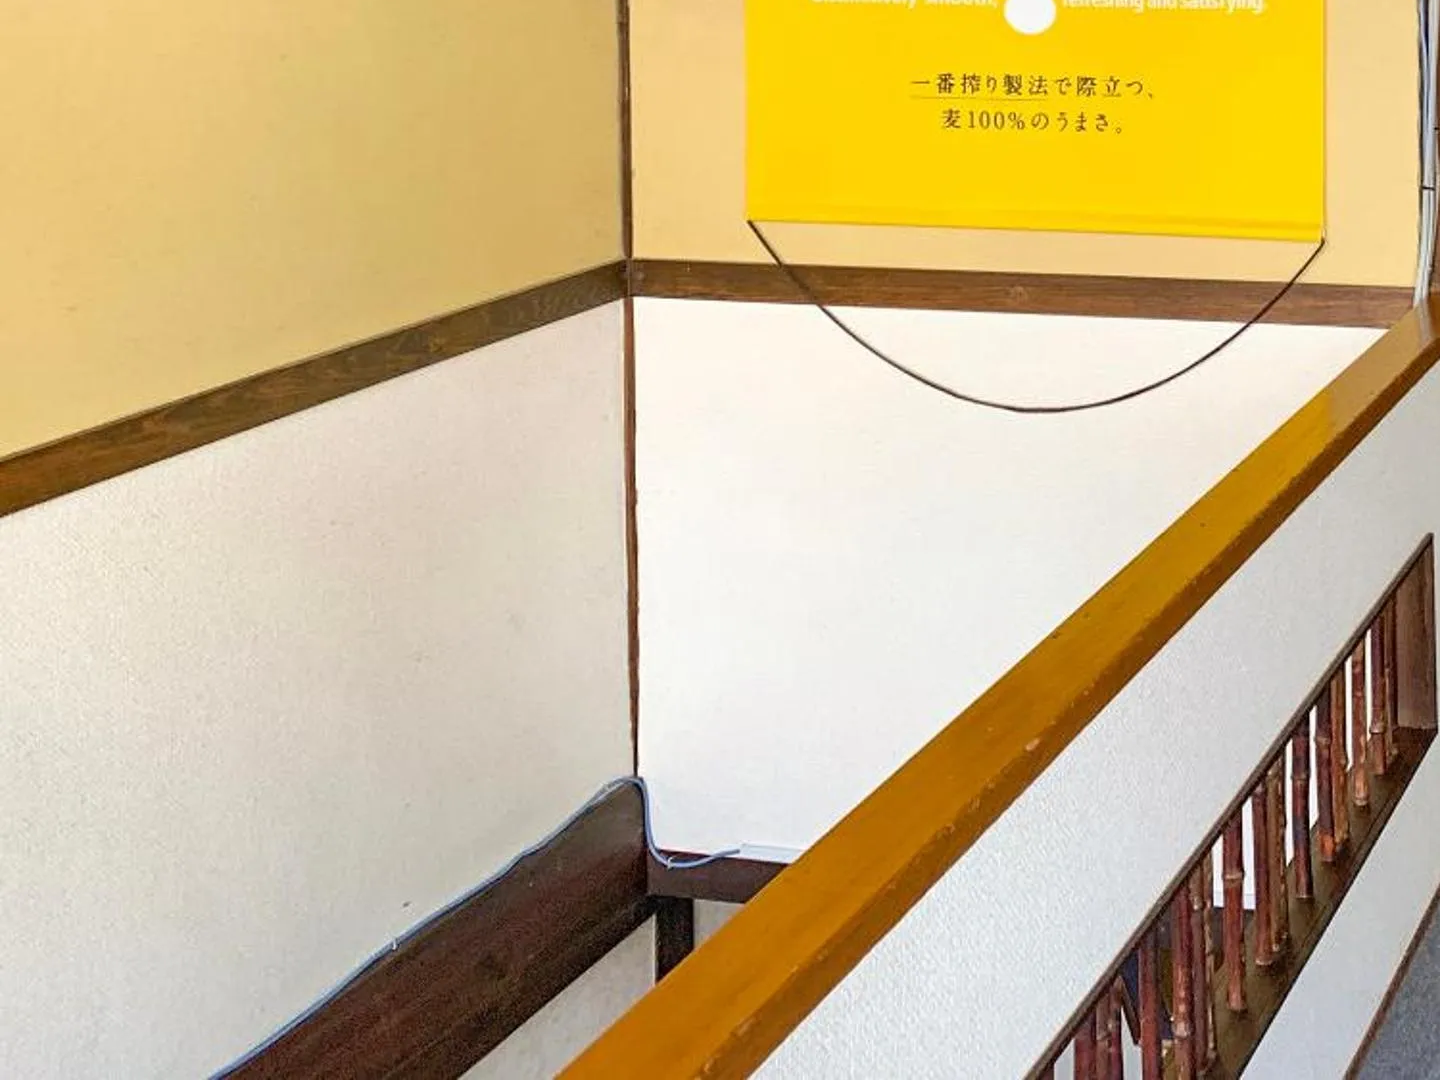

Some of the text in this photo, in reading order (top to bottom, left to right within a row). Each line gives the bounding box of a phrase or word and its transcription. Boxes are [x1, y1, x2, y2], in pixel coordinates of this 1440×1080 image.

[910, 73, 1154, 99] 一番搾り製法で際立つ、
[941, 109, 1123, 134] 麦100%のうまさ。
